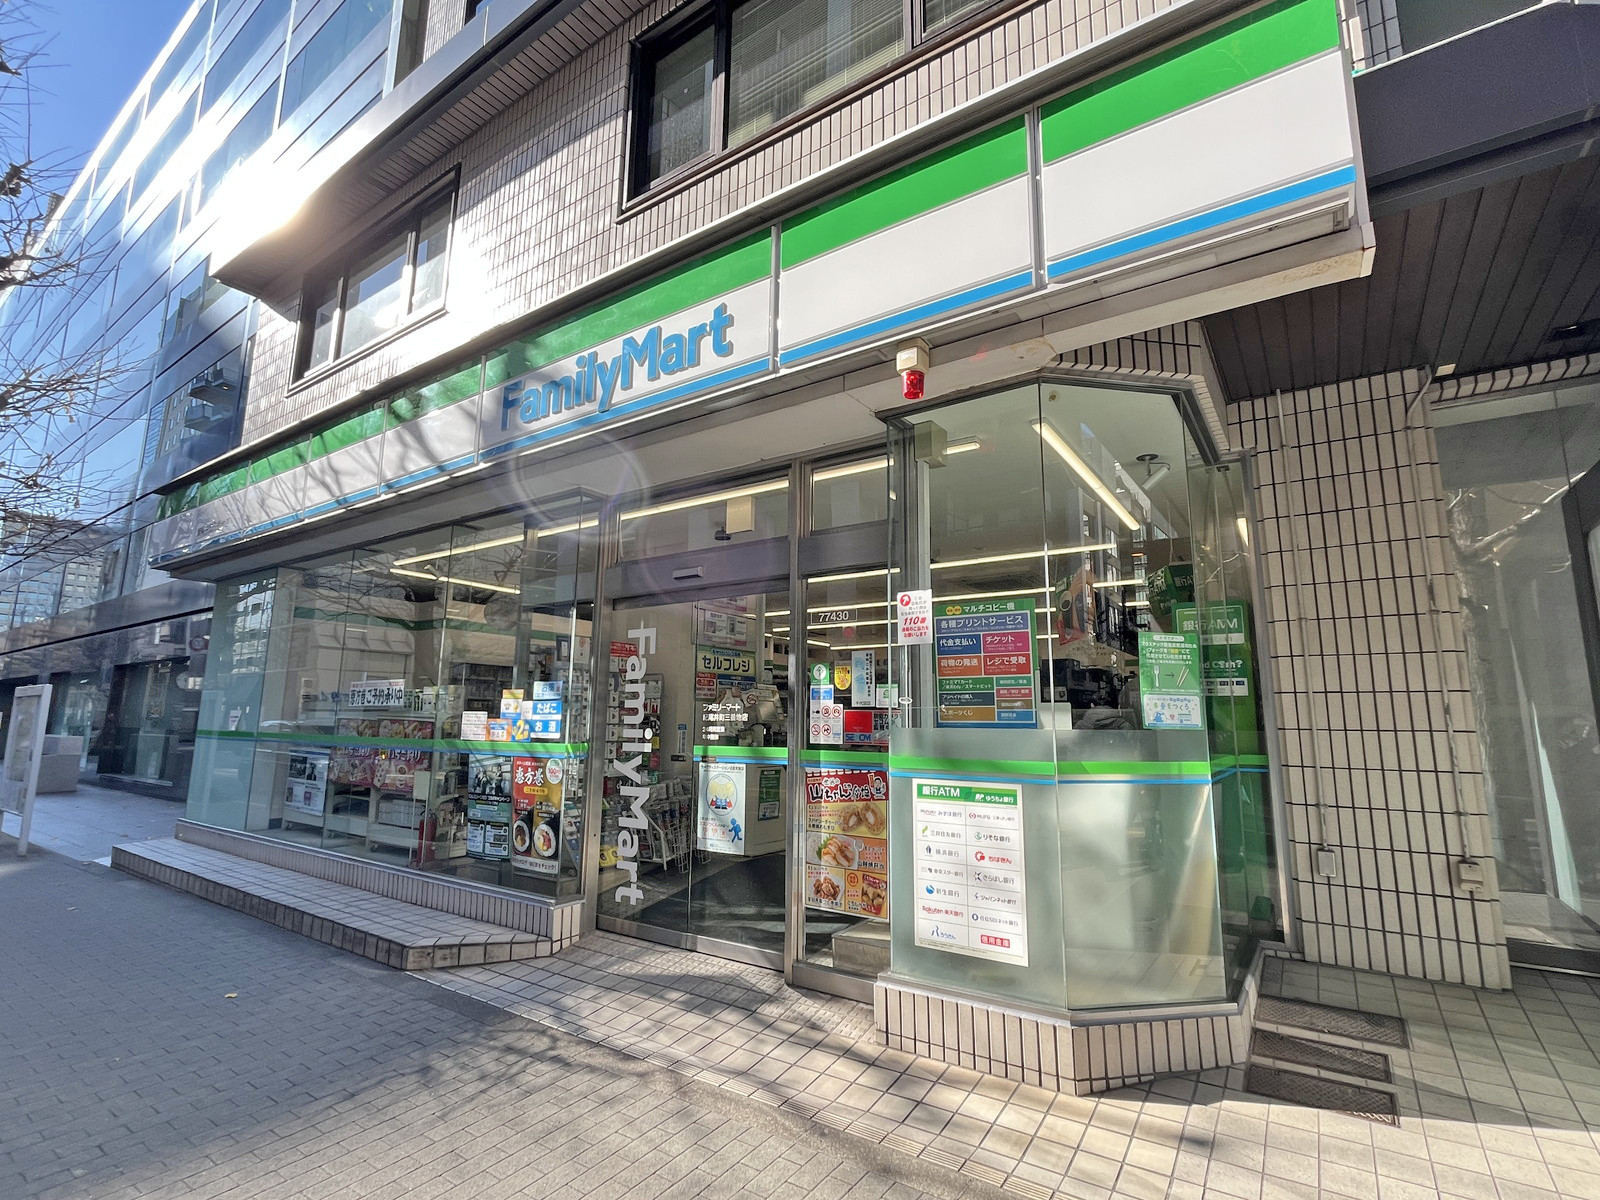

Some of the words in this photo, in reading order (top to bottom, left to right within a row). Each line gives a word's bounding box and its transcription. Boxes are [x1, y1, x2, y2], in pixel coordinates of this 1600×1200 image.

[501, 302, 734, 432] FamilyMart
[963, 603, 1015, 612] マルチコピー機
[819, 611, 849, 622] 77430
[941, 616, 1023, 629] 各種プリントサービス
[940, 637, 976, 647] 代金支払い
[985, 635, 1015, 644] チケット
[702, 655, 750, 673] セルフレジ
[940, 658, 979, 667] 荷物の発送
[987, 656, 1027, 666] レジで受取
[537, 703, 557, 714] たばこ
[703, 703, 741, 712] ファミリーマート
[613, 627, 656, 906] FamilyMart
[515, 766, 544, 786] 恵方巻
[922, 785, 960, 797] 銀行ATM
[985, 795, 1014, 803] ゆうちょ銀行
[983, 834, 1011, 842] りそな銀行
